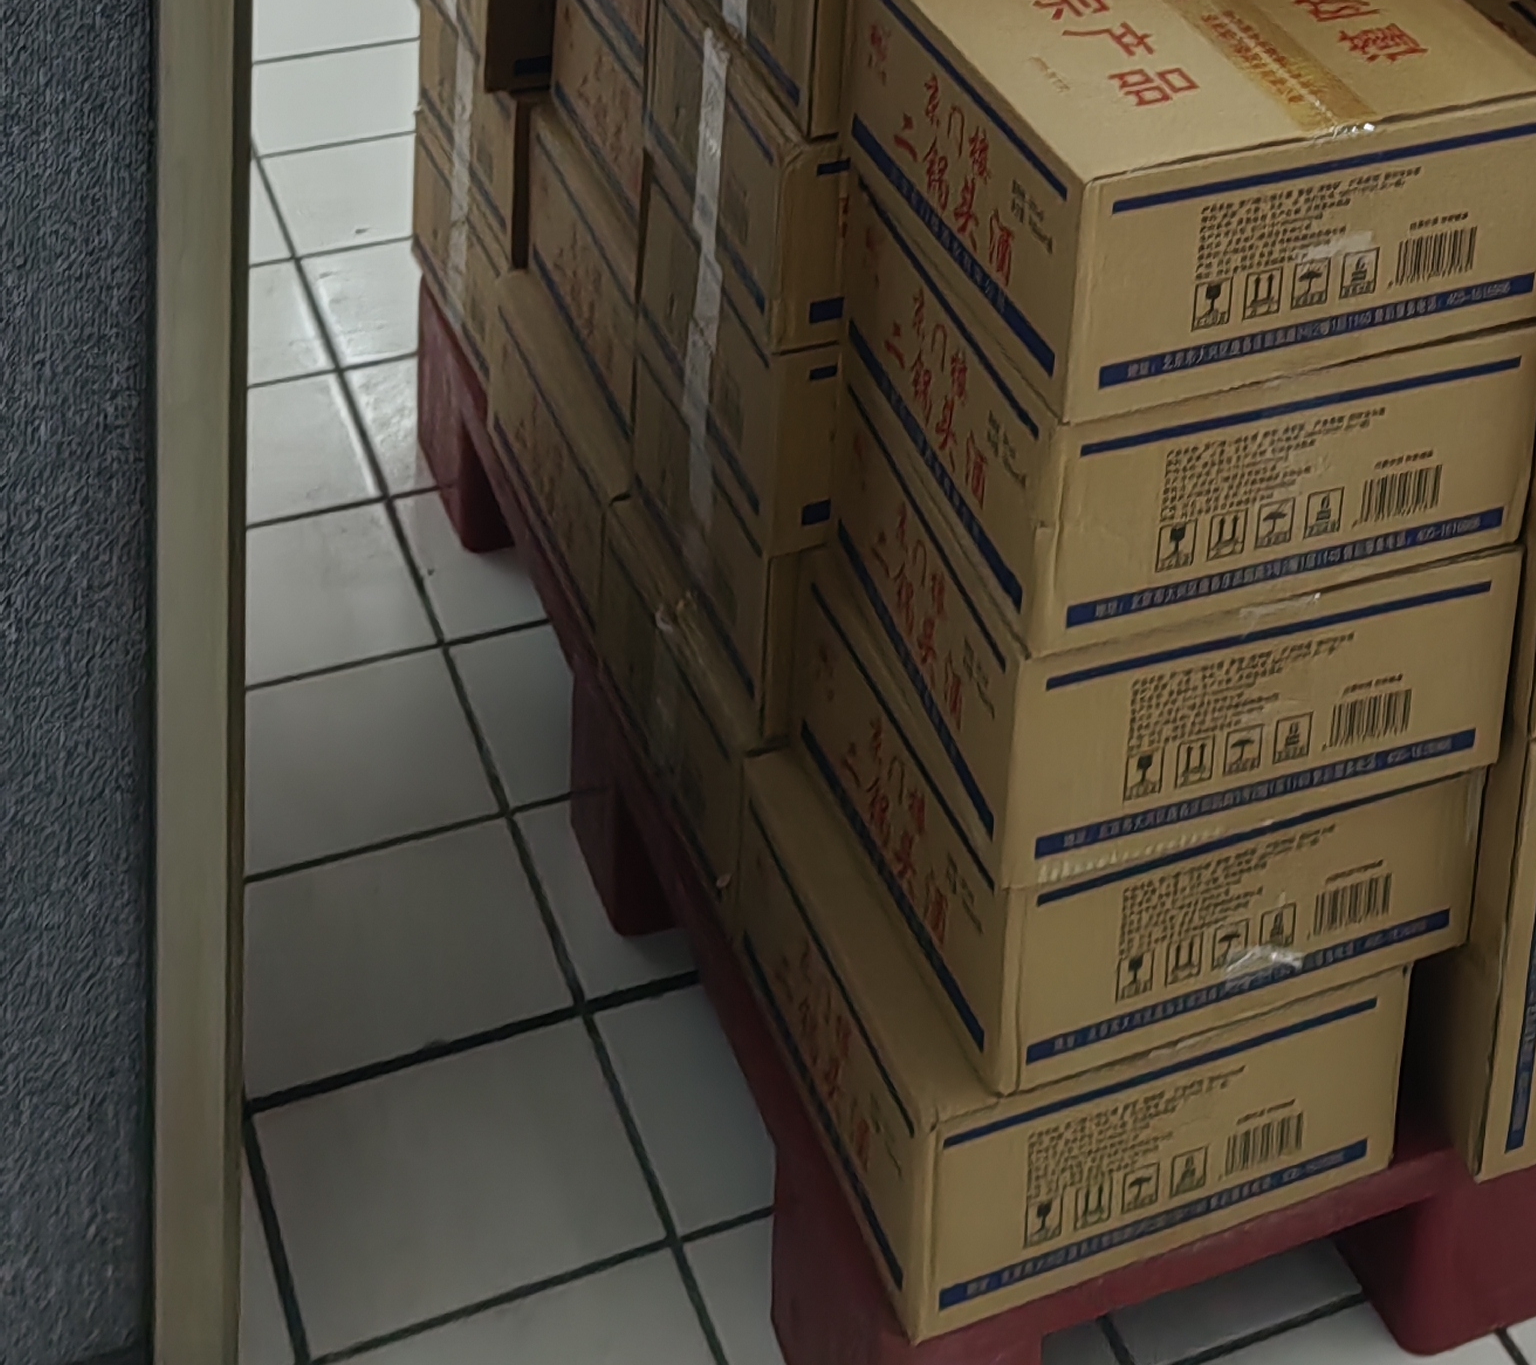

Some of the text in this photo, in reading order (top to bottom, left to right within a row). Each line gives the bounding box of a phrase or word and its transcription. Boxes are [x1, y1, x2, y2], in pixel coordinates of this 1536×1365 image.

[892, 111, 1017, 291] 二锅头酒
[923, 73, 993, 185] 京门楼
